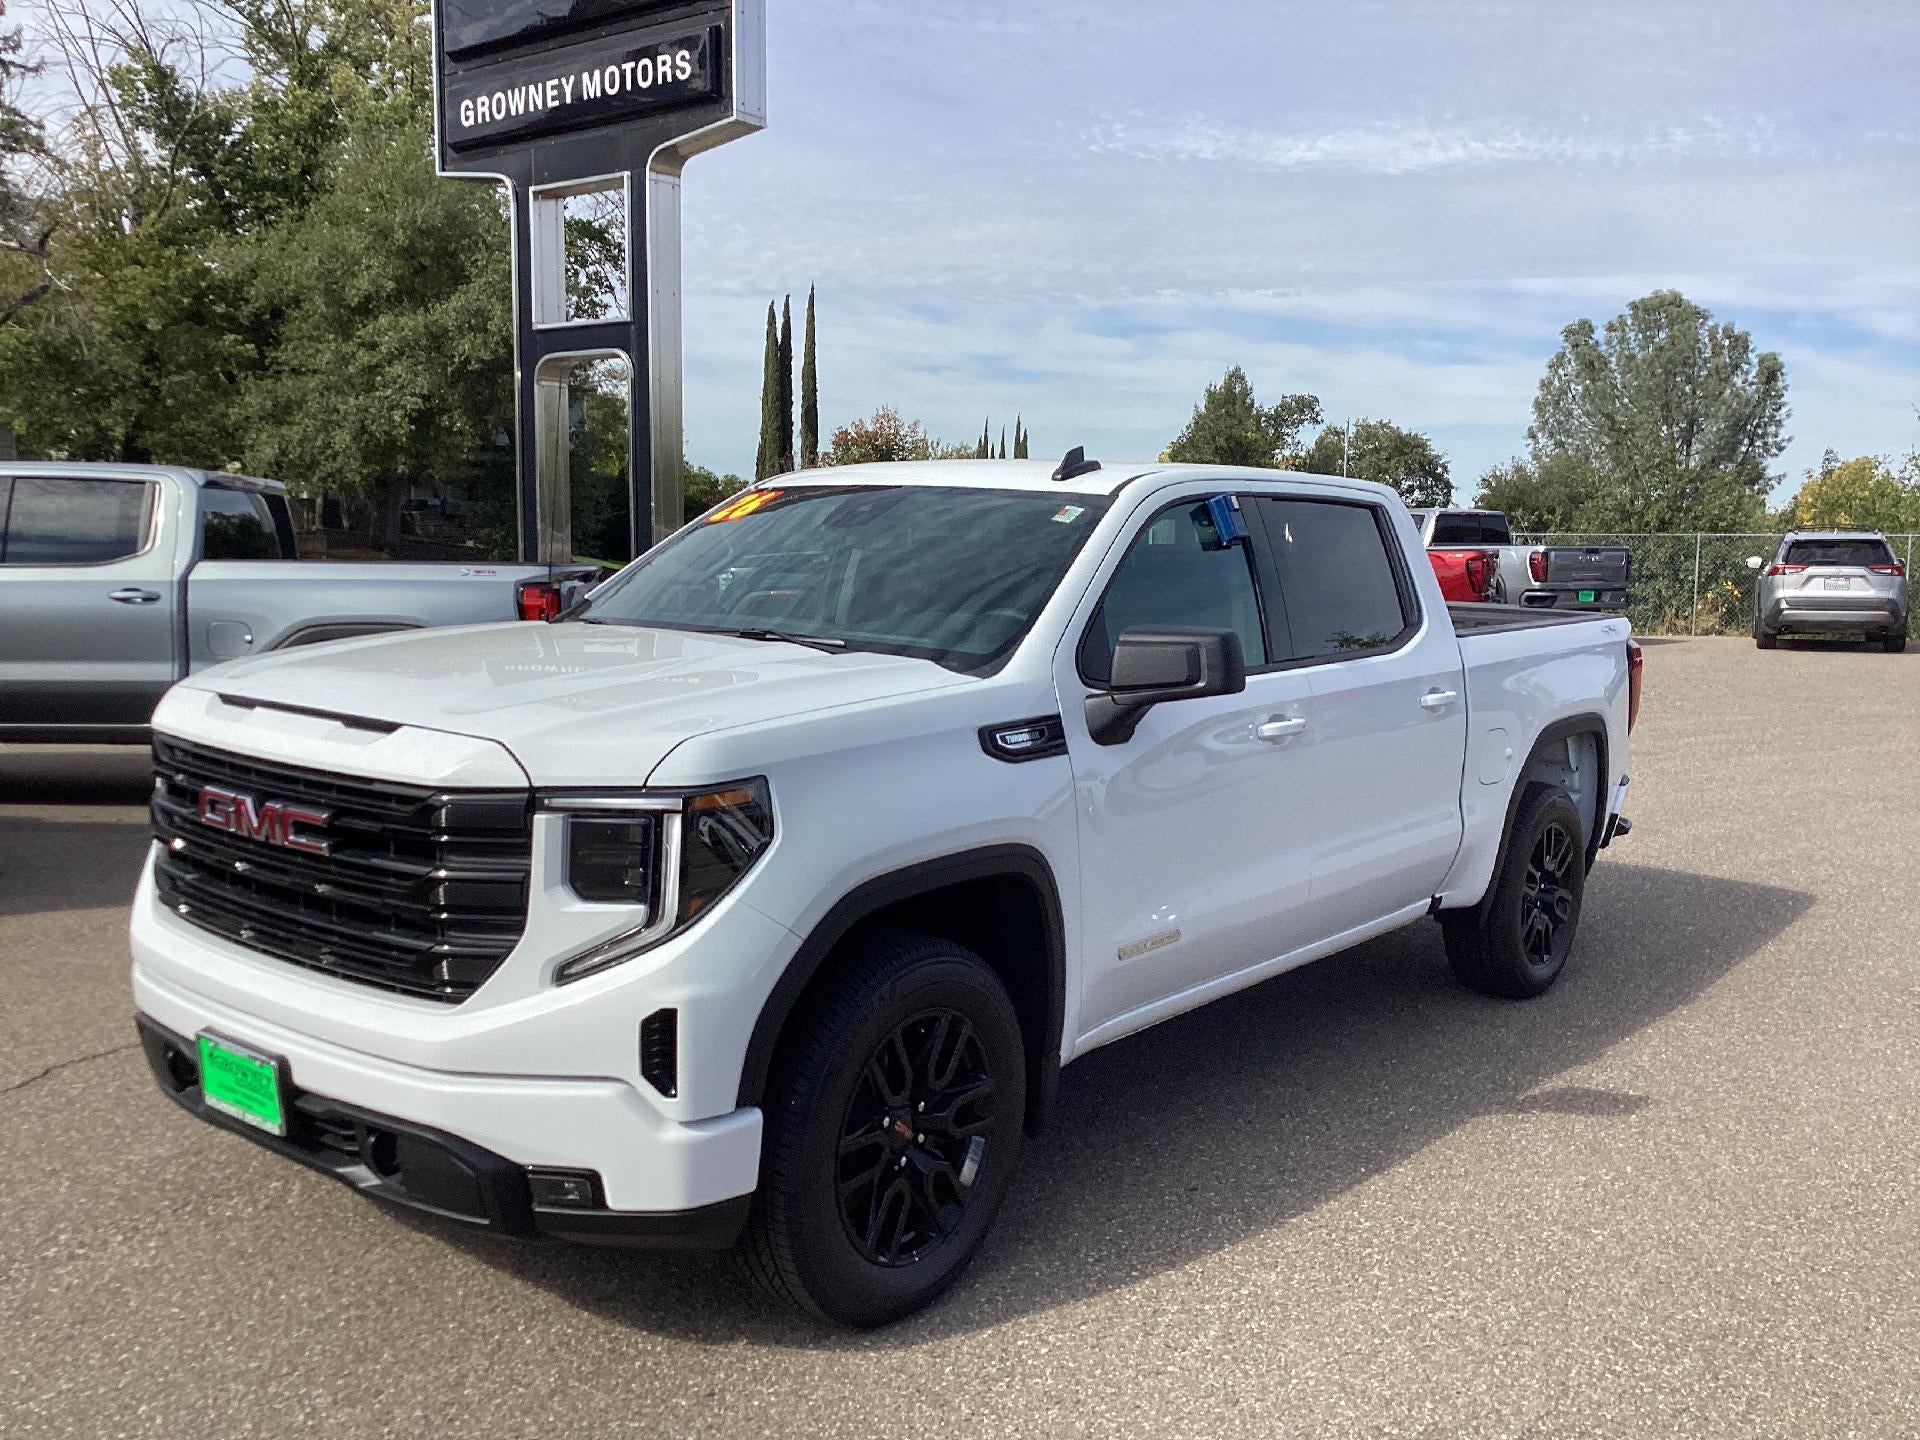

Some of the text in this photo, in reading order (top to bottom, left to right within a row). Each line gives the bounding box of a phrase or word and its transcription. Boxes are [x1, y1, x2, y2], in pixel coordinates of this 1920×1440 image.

[460, 50, 692, 127] GROWNEY MOTORS
[198, 785, 330, 856] GMC
